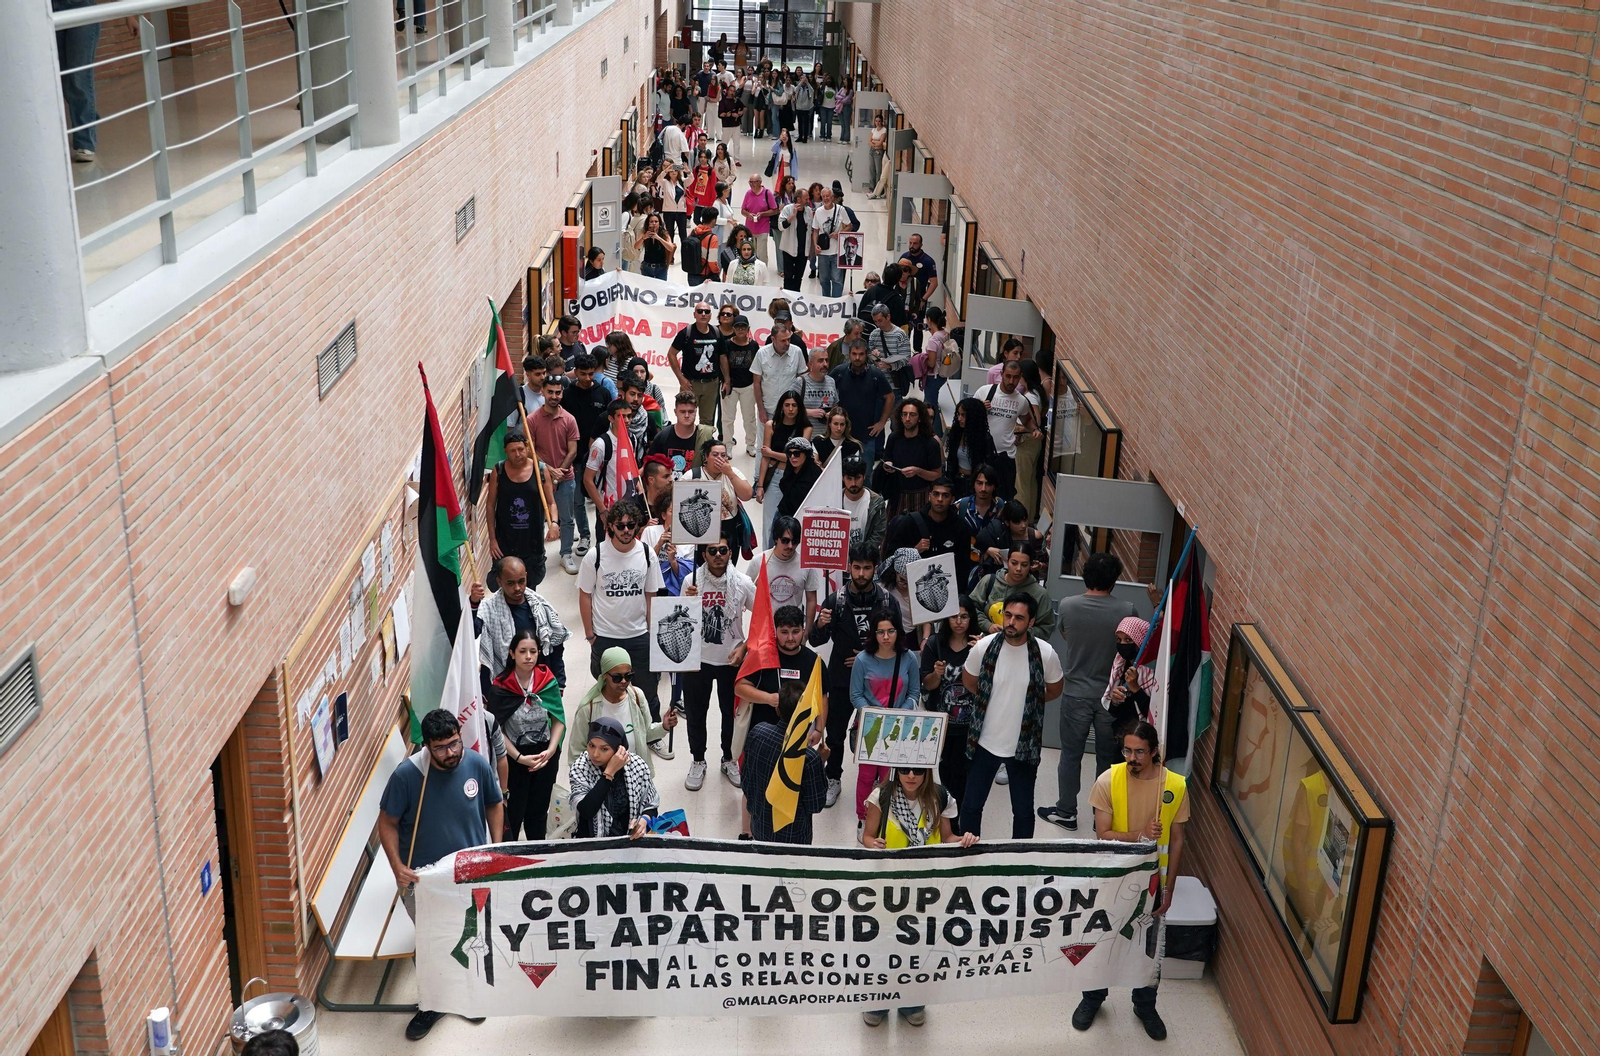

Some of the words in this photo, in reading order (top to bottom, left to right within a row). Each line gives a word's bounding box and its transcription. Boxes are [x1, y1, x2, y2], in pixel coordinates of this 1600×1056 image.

[568, 282, 657, 316] GOBIERNO
[665, 288, 767, 312] ESPAÑOL
[771, 296, 859, 318] ÓMPLI
[992, 397, 1020, 409] OLLISTER
[811, 520, 830, 529] ALTO
[830, 521, 840, 529] AL
[804, 529, 846, 539] GENOCIDIO
[806, 538, 842, 548] SIONISTA
[809, 548, 819, 556] DE
[820, 548, 840, 558] GAZA
[605, 589, 643, 597] DOWN
[702, 591, 726, 600] STA
[521, 882, 725, 920] CONTRA
[741, 884, 796, 914] LA
[811, 876, 1099, 918] OCUPACIÓN
[499, 922, 530, 951] Y
[547, 920, 595, 951] EL
[611, 913, 880, 948] APARTHEID
[895, 909, 1113, 947] SIONISTA
[666, 954, 698, 971] AL
[714, 951, 872, 968] COMERCIO
[889, 954, 920, 970] DE
[937, 946, 1034, 969] ARMAS
[586, 957, 660, 991] FIN
[666, 974, 680, 990] A
[690, 971, 732, 988] LAS
[741, 969, 889, 986] RELACIONES
[897, 968, 947, 985] CON
[956, 960, 1033, 980] ISRAEL
[722, 991, 902, 1009] @MALAGAPORPALESTINA
